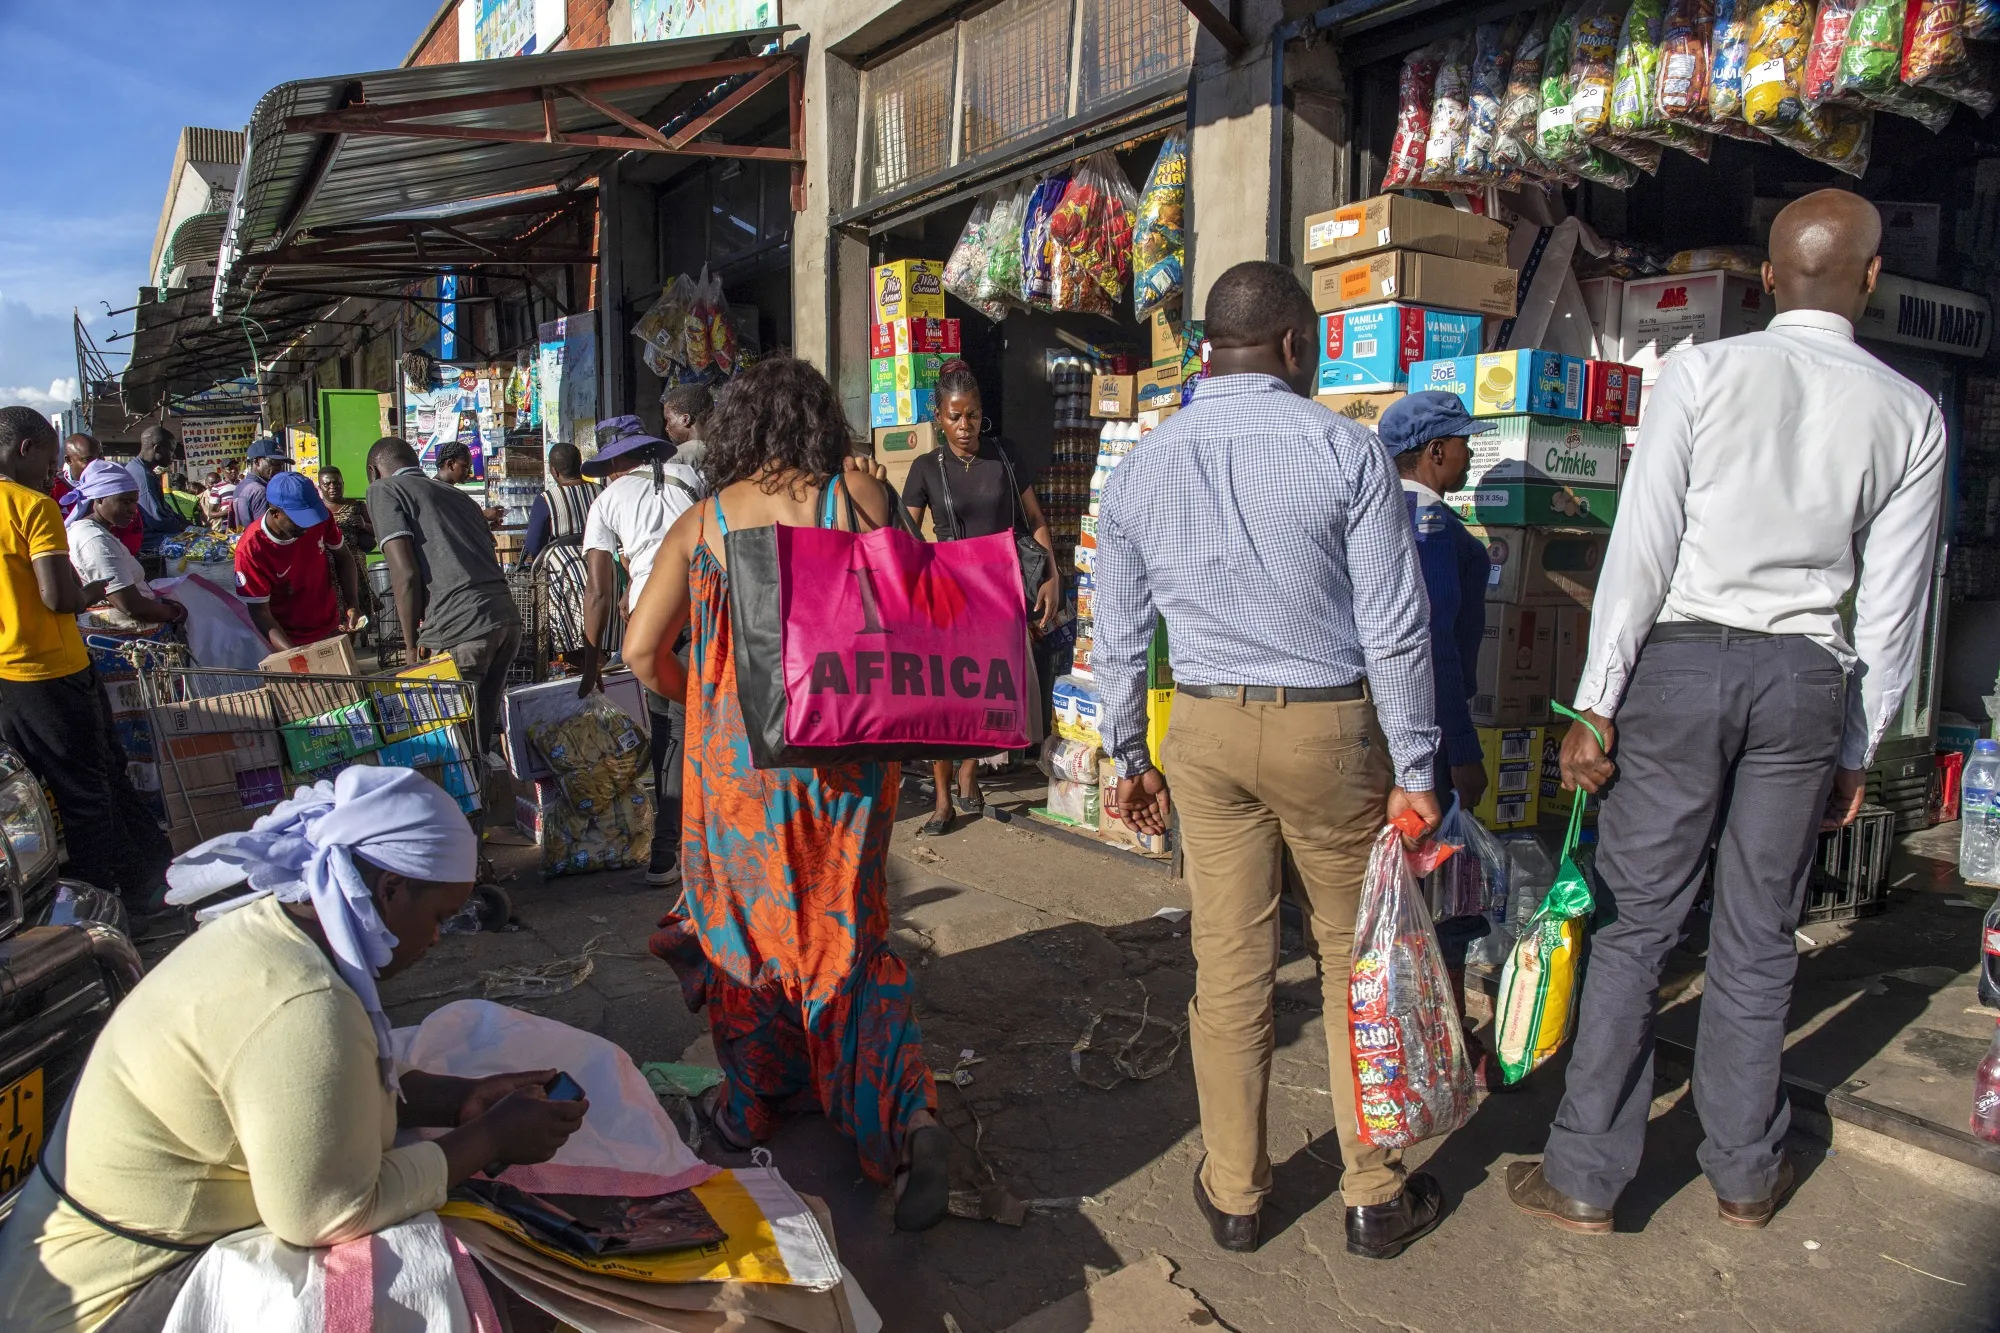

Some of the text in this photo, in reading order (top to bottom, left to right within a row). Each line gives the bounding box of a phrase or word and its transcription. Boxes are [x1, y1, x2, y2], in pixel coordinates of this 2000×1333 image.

[1582, 88, 1598, 99] 20
[886, 277, 901, 292] Wish
[918, 274, 940, 287] Wish
[913, 283, 940, 294] Creams
[881, 289, 902, 305] Creams
[1348, 312, 1384, 326] VANILLA
[1897, 293, 1985, 349] MINI MART
[926, 329, 943, 337] Milk
[1354, 323, 1377, 332] BISCUITS
[1427, 321, 1467, 334] VANILLA
[1432, 335, 1461, 343] BISCUITS
[927, 360, 940, 368] JOE
[1543, 362, 1561, 378] JOE
[876, 371, 893, 381] Lemon
[1431, 367, 1456, 381] JOE
[1608, 374, 1622, 387] JOE
[1099, 377, 1119, 394] Jade
[1538, 375, 1566, 394] Vanilla
[1605, 388, 1622, 401] Milk
[879, 405, 895, 414] Vanilla
[1596, 405, 1604, 414] 24
[183, 426, 257, 437] PHOTOCOPYIN
[185, 442, 223, 450] PASSPORT
[187, 448, 248, 459] LAMINATI
[1545, 446, 1597, 477] Crinkles
[1491, 494, 1504, 503] 35g
[847, 567, 893, 636] I
[808, 650, 1018, 701] AFRICA
[301, 730, 349, 752] Lemon
[1936, 735, 1971, 746] NILLA
[298, 759, 310, 769] 24
[601, 1261, 654, 1277] plaster
